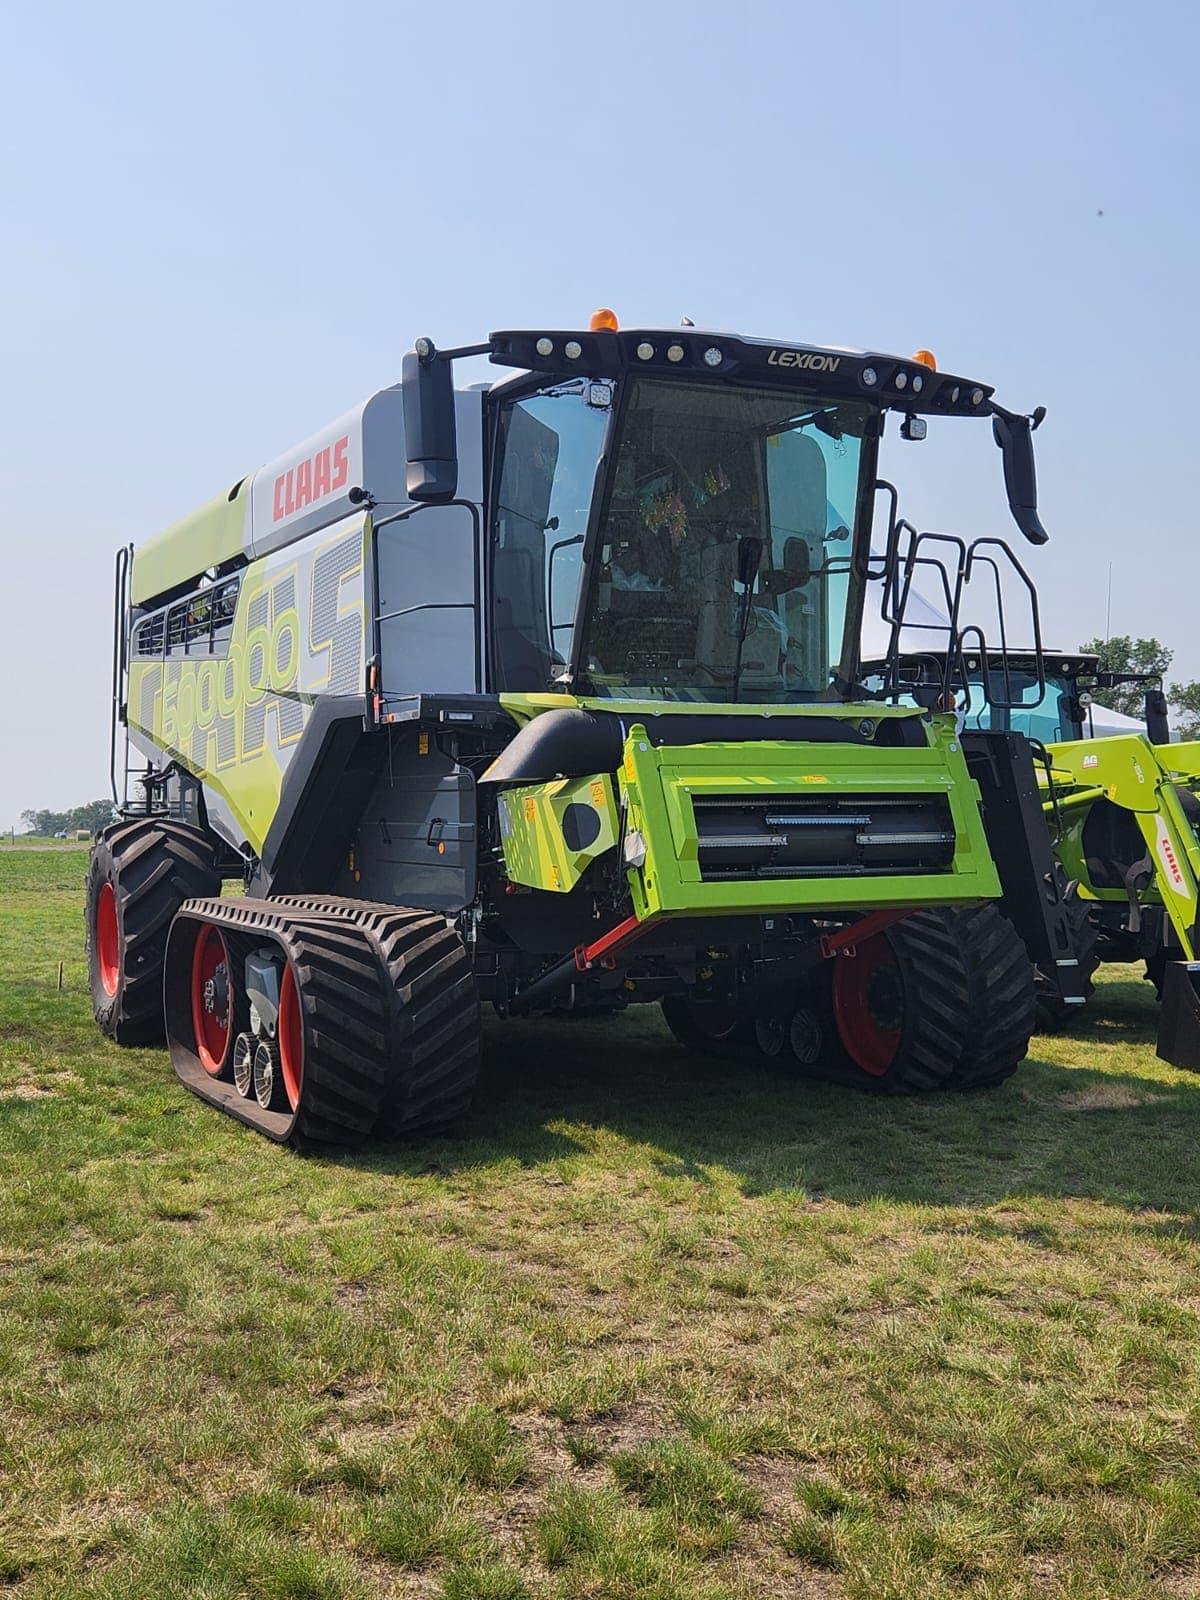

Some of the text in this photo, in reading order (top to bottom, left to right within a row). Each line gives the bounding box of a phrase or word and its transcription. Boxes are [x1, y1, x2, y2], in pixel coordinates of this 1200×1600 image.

[767, 350, 841, 372] LEXION
[273, 434, 350, 522] CLAAS
[1162, 839, 1183, 884] CLAAS
